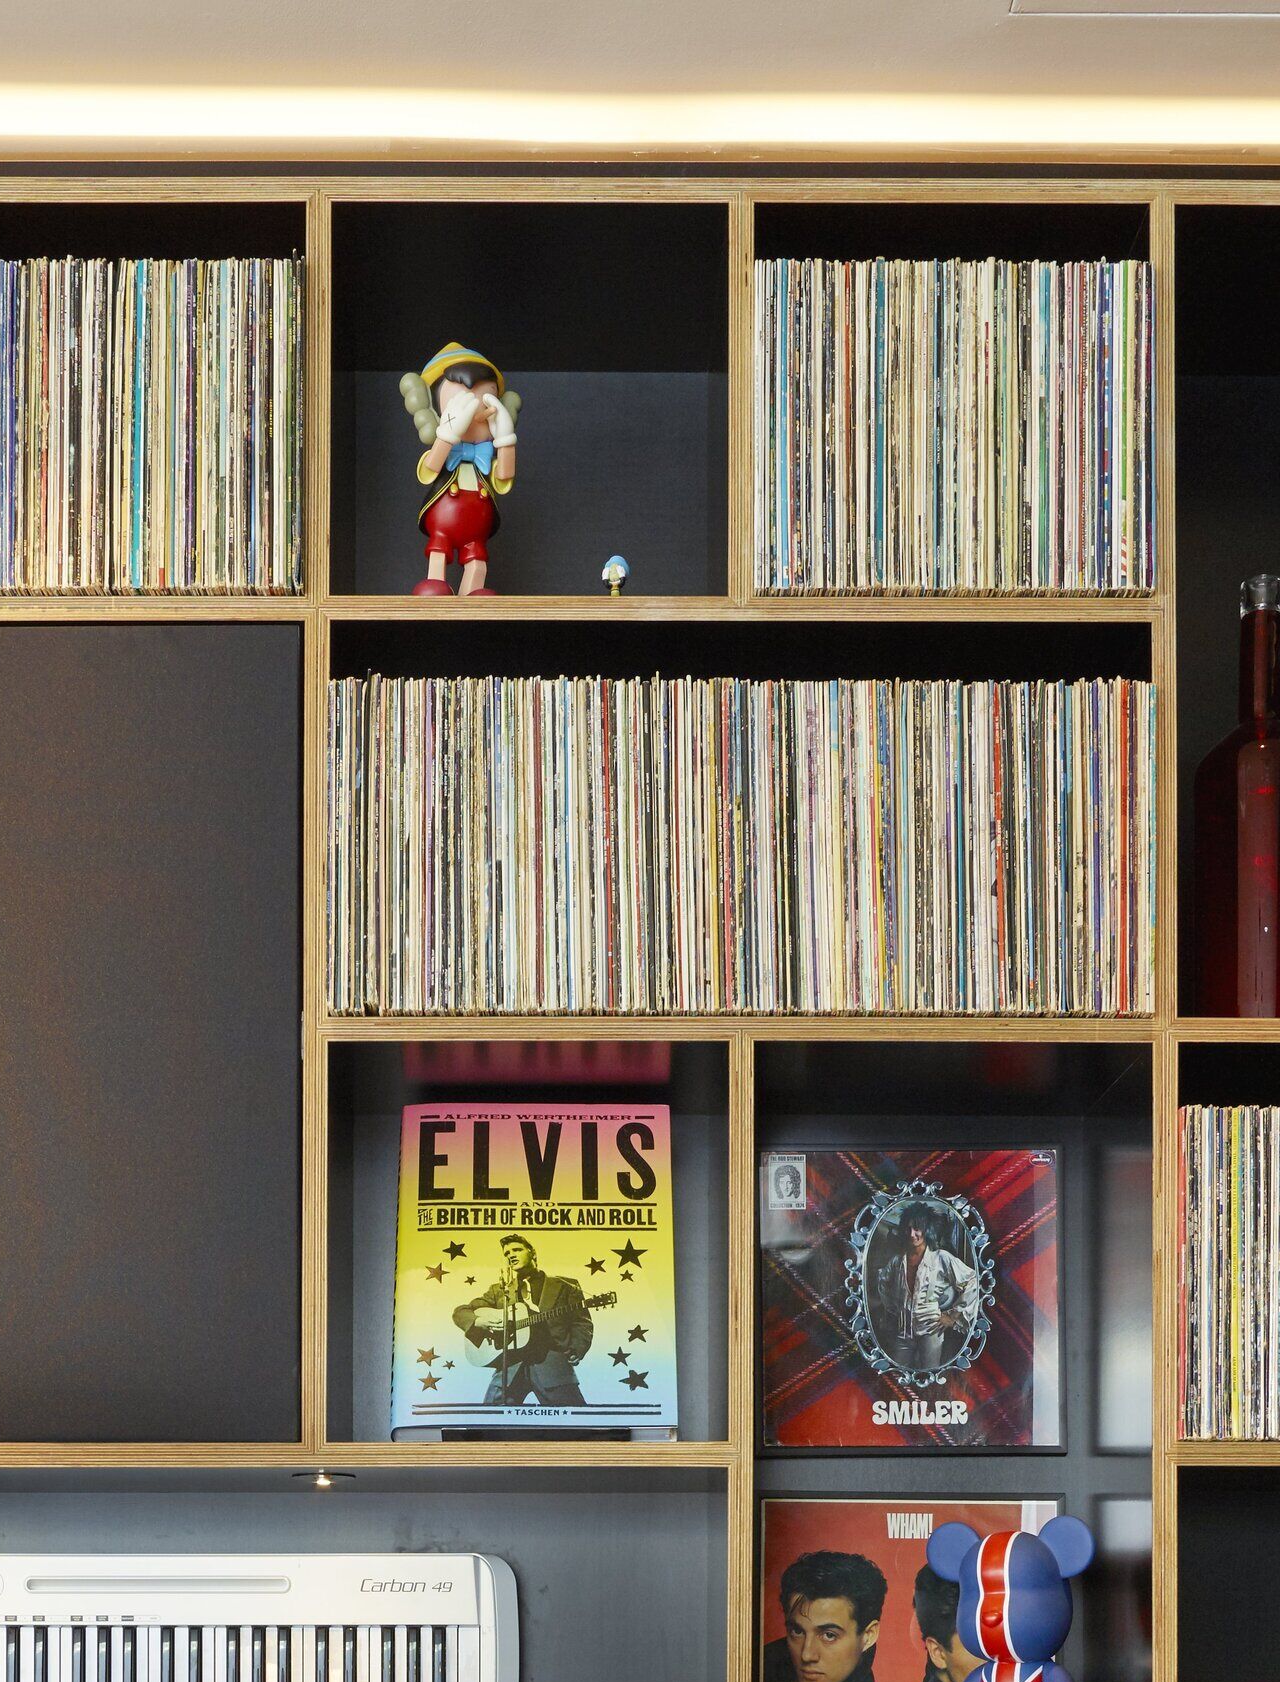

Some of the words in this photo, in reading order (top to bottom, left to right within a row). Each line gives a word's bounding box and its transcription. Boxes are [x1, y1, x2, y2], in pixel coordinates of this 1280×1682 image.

[418, 1121, 658, 1201] ELVIS
[418, 1208, 433, 1226] THE
[436, 1208, 496, 1226] BIRTH
[500, 1208, 518, 1226] OF
[520, 1208, 572, 1226] ROCK
[577, 1209, 606, 1226] AND
[609, 1208, 657, 1226] ROLL
[515, 1408, 560, 1416] TASCHEN
[872, 1400, 968, 1425] SMILER
[886, 1513, 932, 1539] WHAM!
[358, 1577, 426, 1594] Carbon
[432, 1581, 453, 1594] 49
